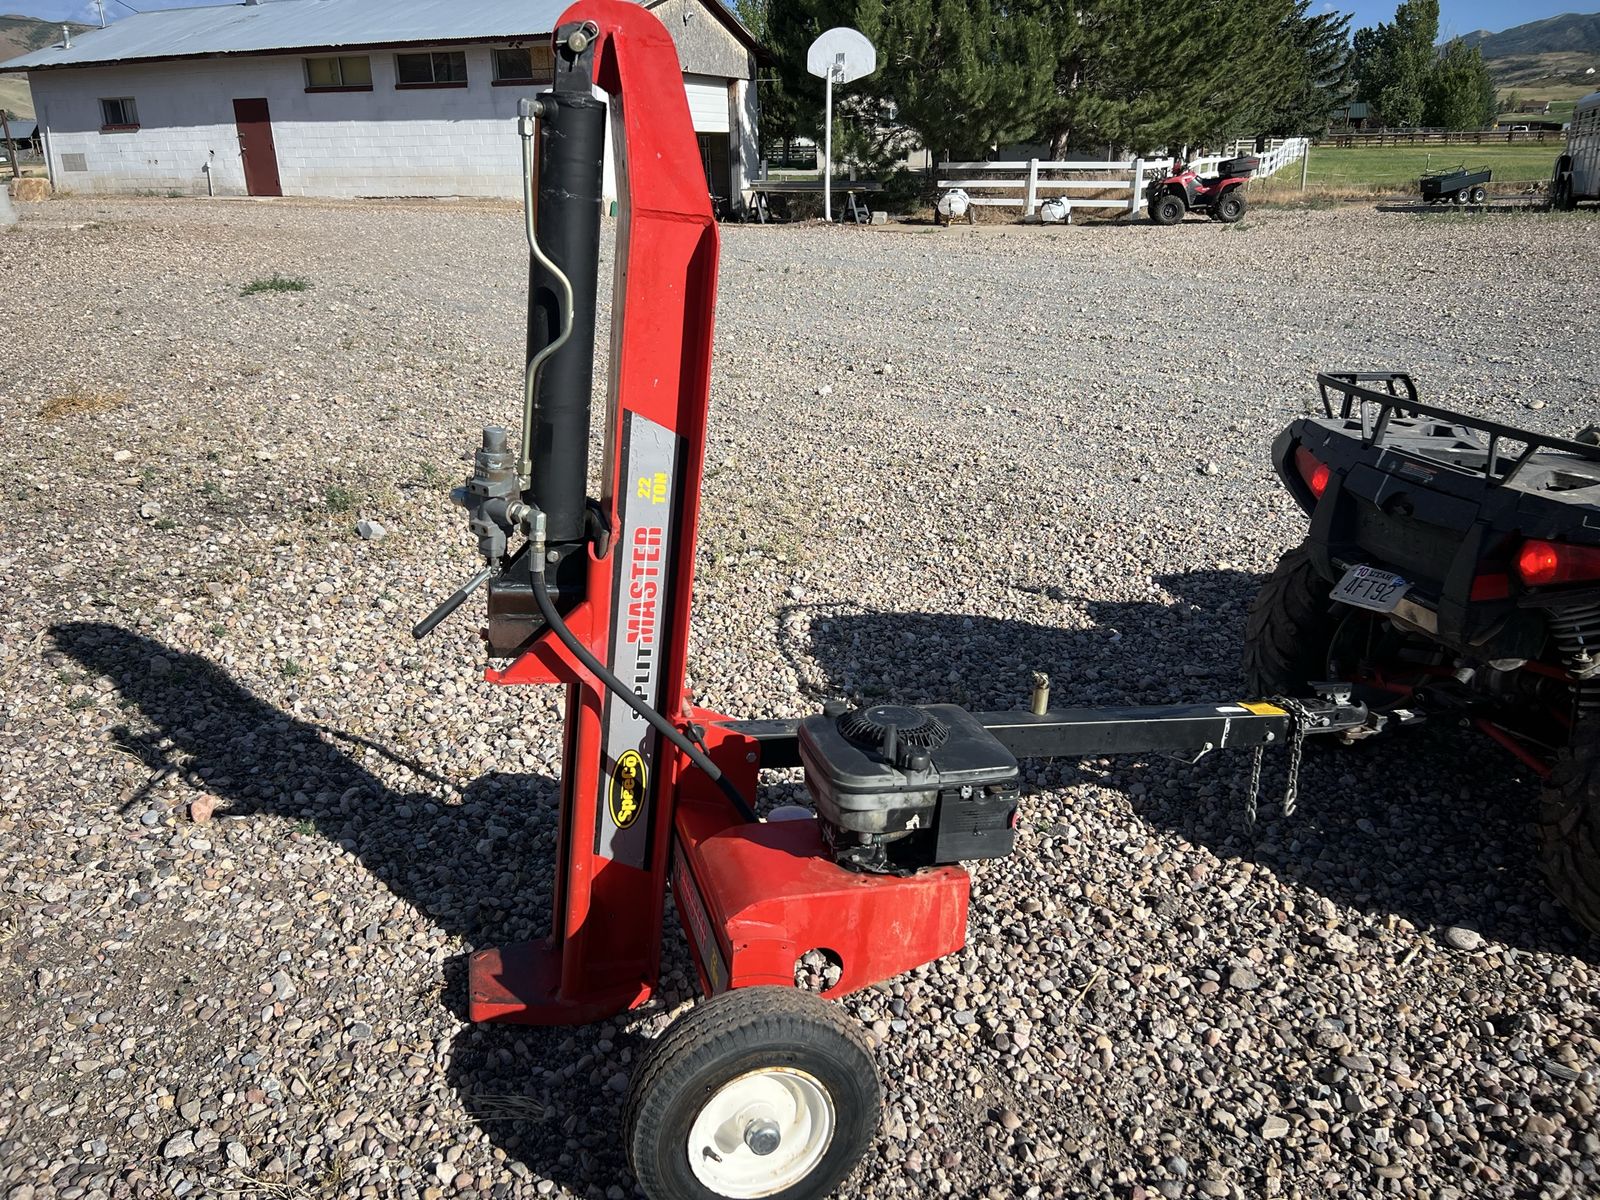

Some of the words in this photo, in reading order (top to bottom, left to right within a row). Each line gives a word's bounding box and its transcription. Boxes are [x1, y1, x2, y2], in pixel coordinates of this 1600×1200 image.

[638, 477, 651, 499] 22
[652, 472, 669, 504] TON
[1368, 570, 1392, 581] UTAH
[1343, 576, 1397, 603] 4FT92
